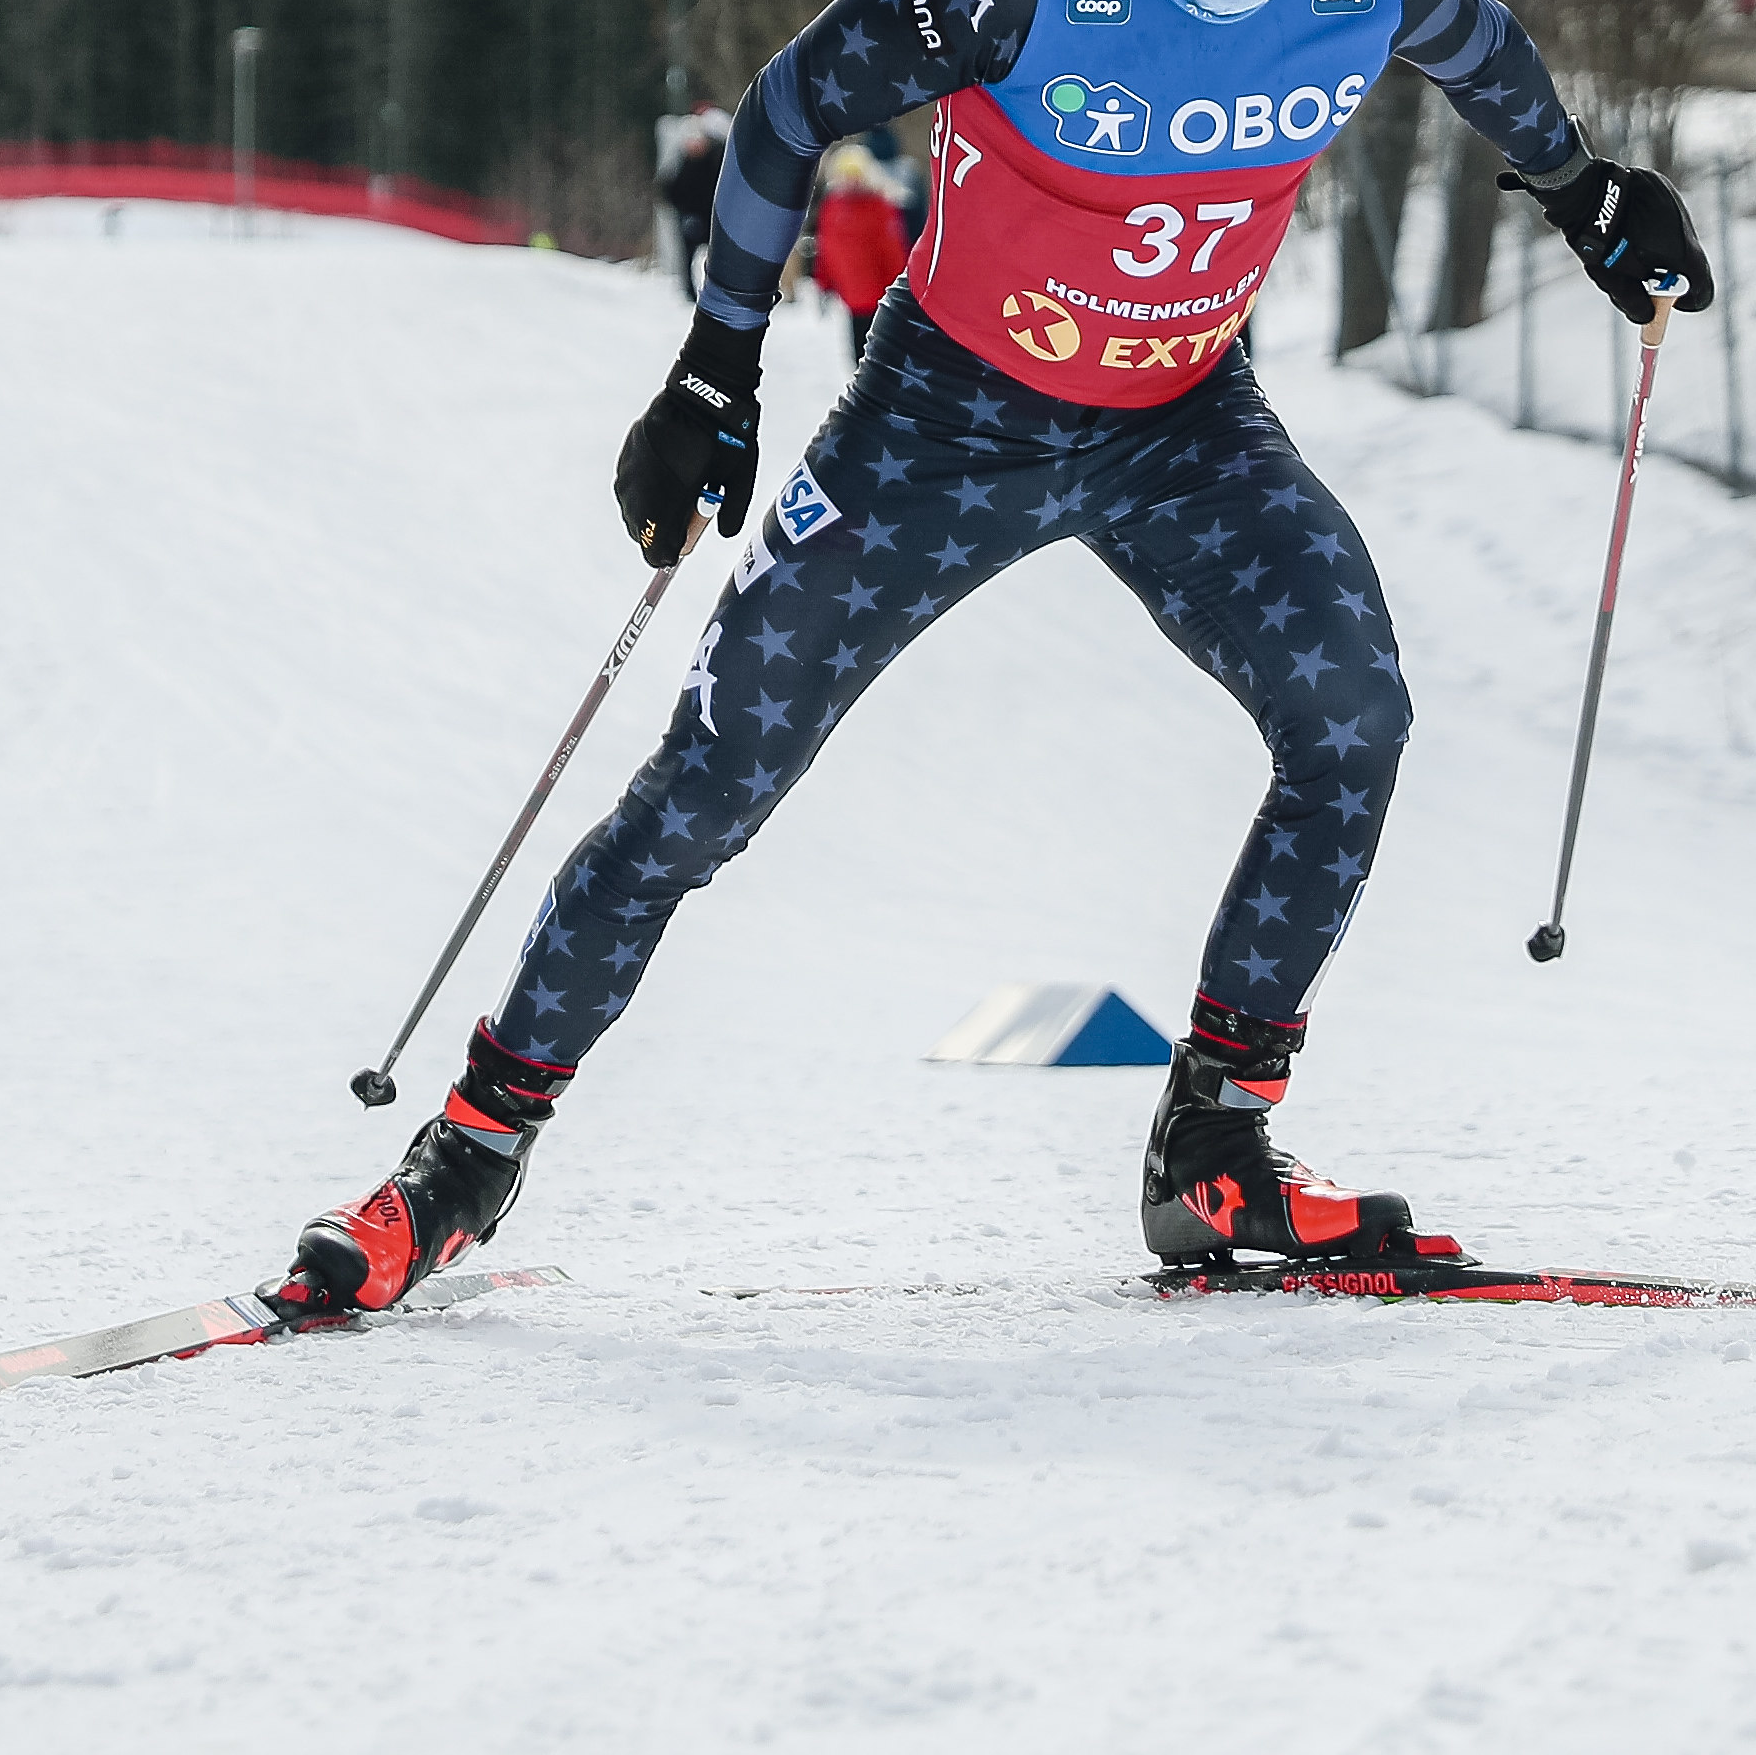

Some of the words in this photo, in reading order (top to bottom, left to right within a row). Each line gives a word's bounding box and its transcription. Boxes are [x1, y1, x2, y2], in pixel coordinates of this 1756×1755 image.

[1076, 0, 1122, 16] coop
[1169, 74, 1367, 155] OBOS
[1594, 179, 1621, 234] SWIX
[1112, 199, 1254, 278] 37
[1045, 265, 1261, 322] HOLMENKOLLEN
[679, 372, 732, 409] SWIX
[601, 597, 654, 686] SWIX
[1281, 1272, 1403, 1295] RSSIGNOL
